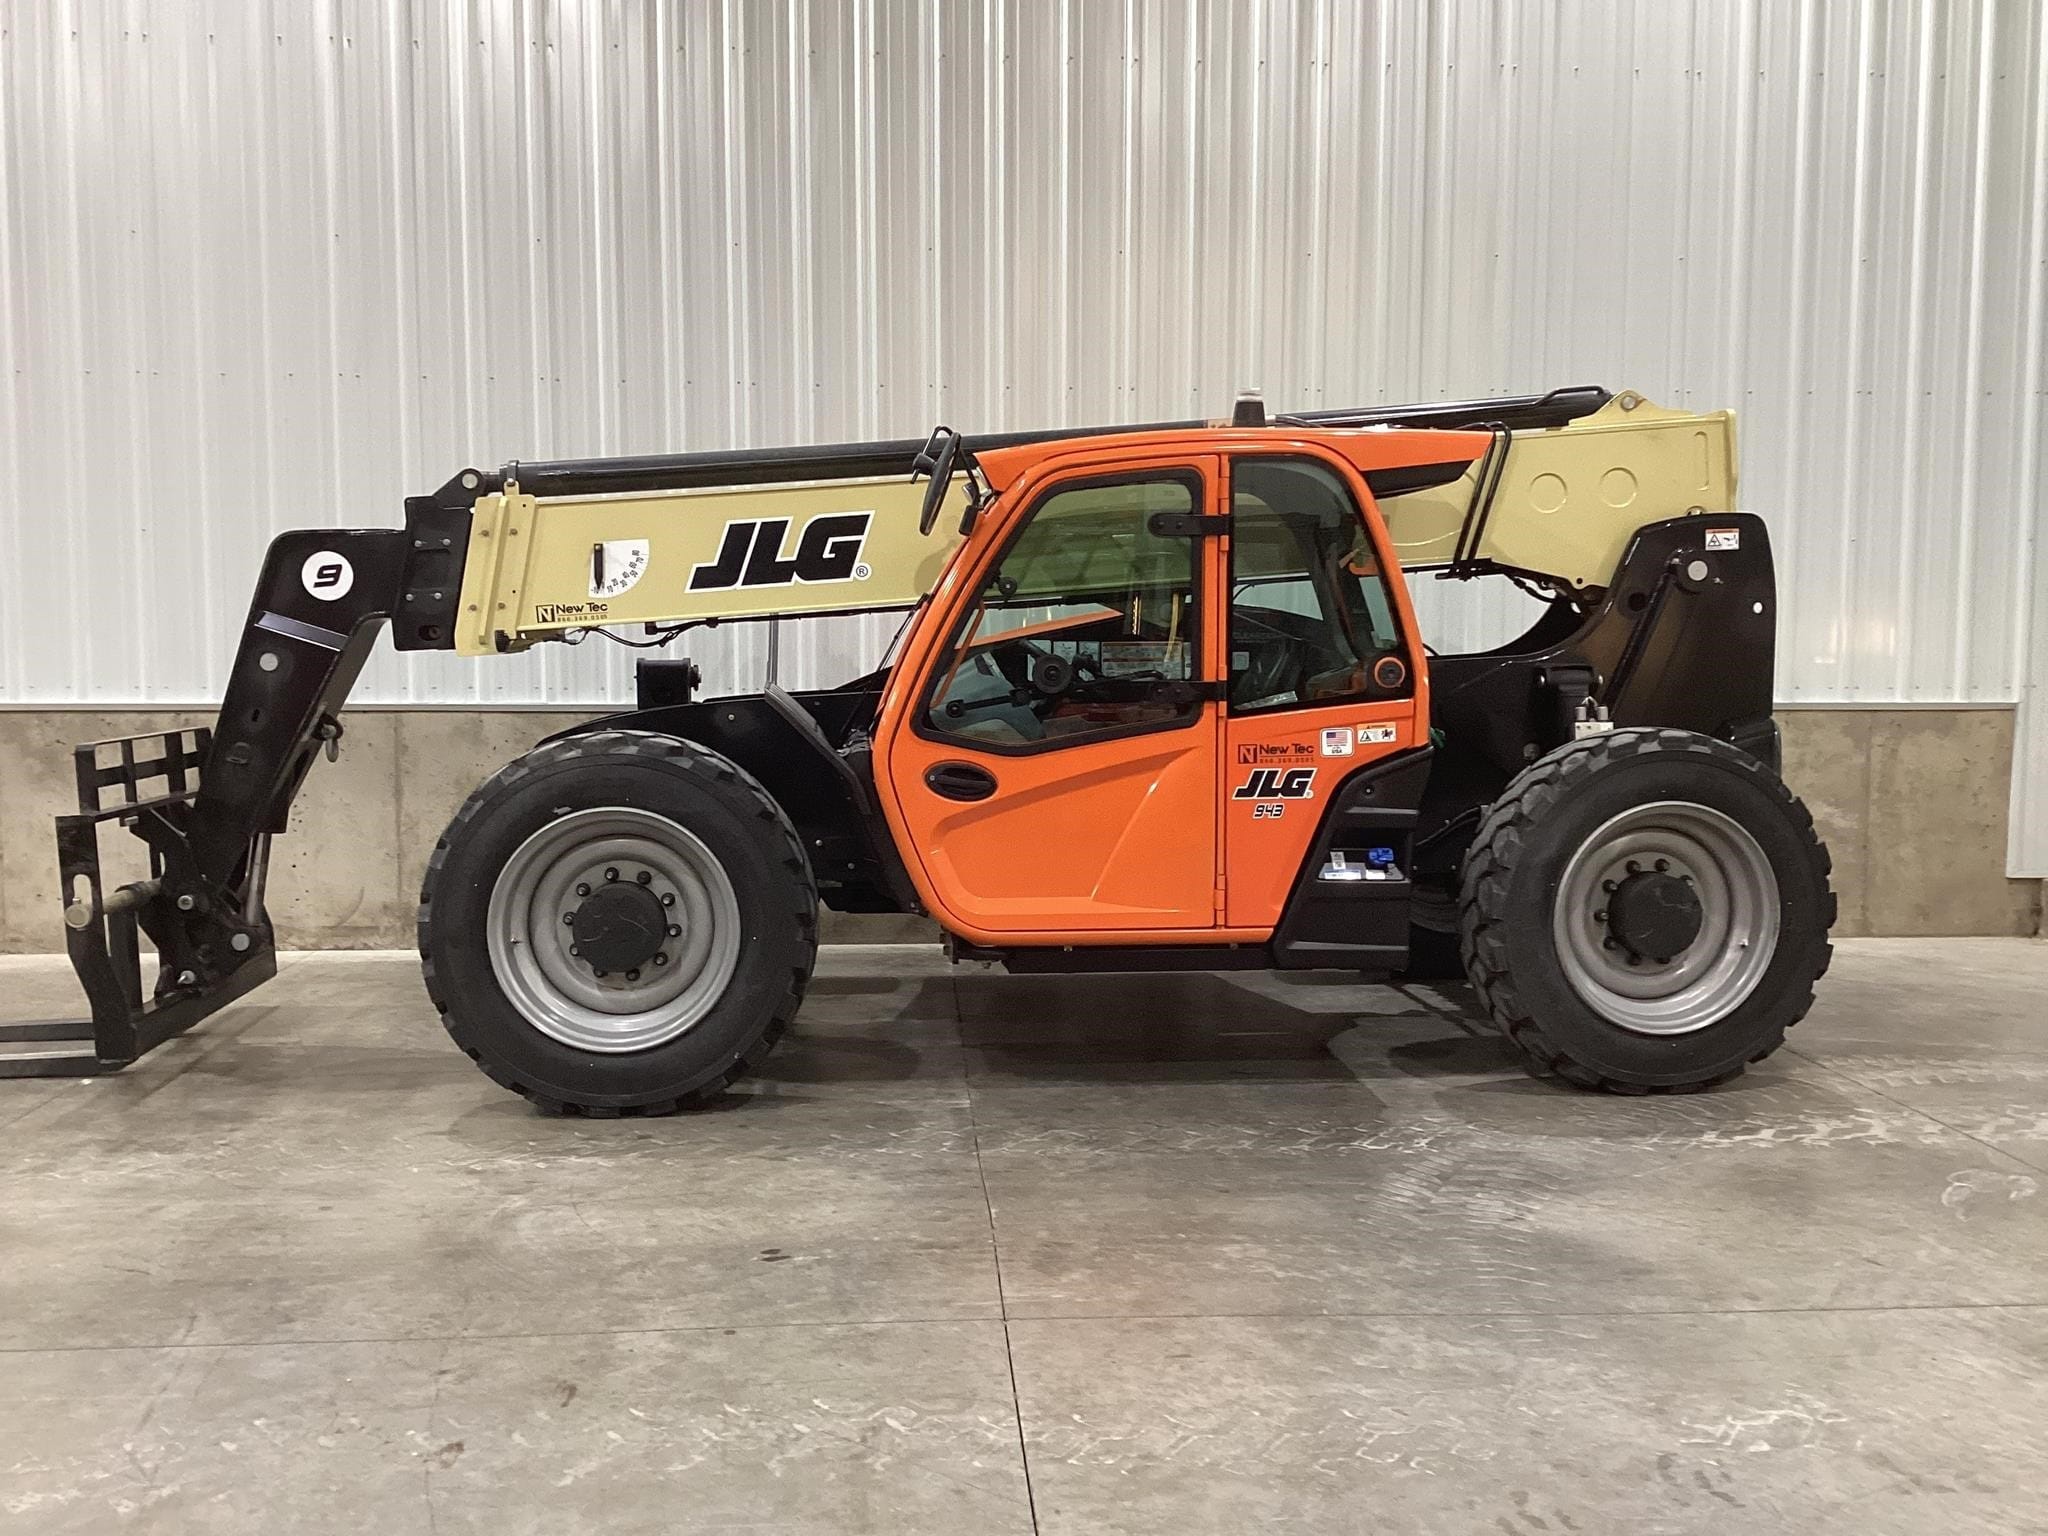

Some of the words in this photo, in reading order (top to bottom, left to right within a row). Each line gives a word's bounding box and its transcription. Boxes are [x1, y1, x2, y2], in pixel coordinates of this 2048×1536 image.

[313, 564, 342, 588] 9
[556, 604, 584, 614] New
[586, 602, 608, 612] Tec
[1260, 744, 1289, 754] New
[1292, 743, 1314, 754] Tec
[1254, 803, 1285, 818] 943
